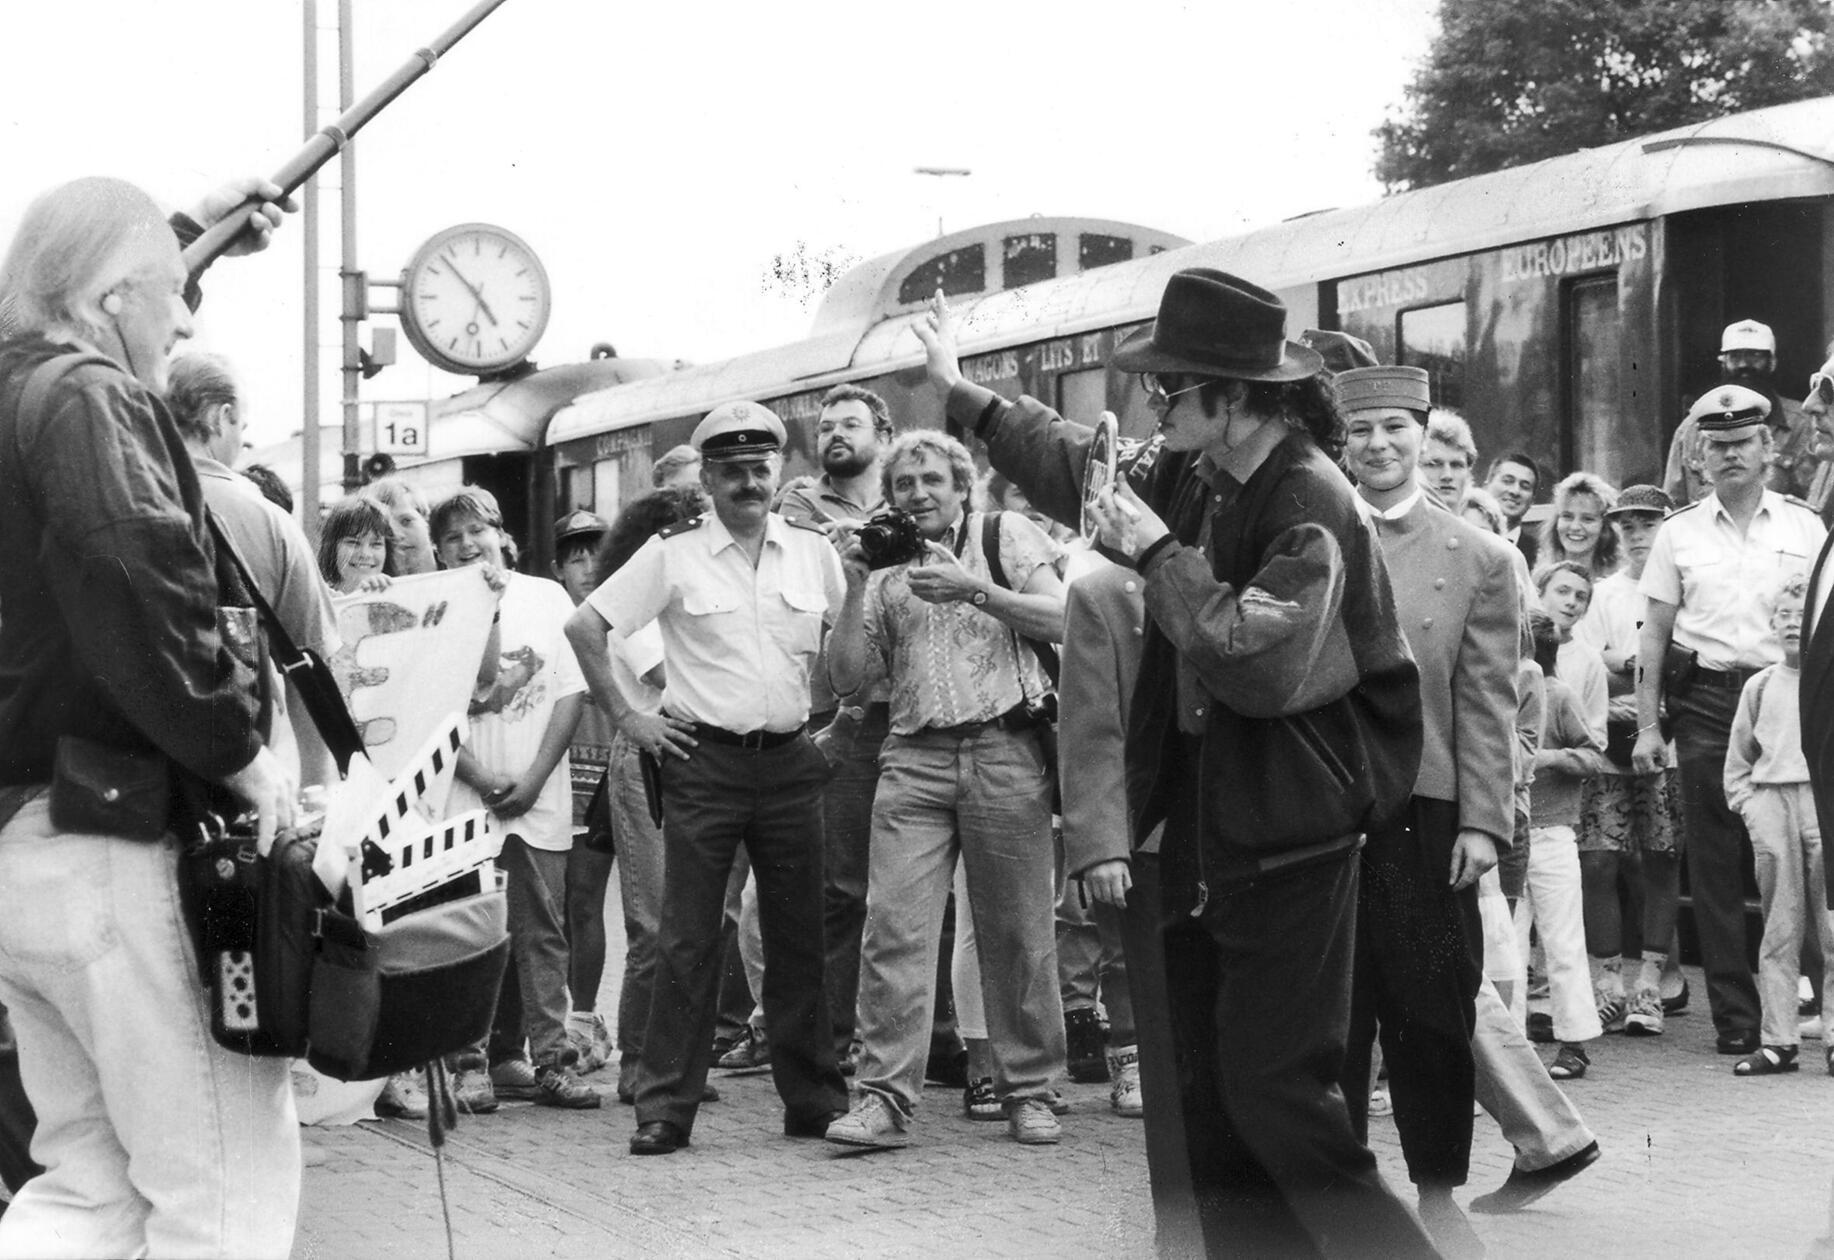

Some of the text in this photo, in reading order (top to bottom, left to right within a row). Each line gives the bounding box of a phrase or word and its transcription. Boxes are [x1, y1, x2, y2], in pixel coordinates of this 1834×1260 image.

[961, 350, 1019, 384] WAGONS
[1081, 332, 1103, 363] ET
[1336, 267, 1428, 314] EXPRESS
[1501, 222, 1647, 283] EUROPEENS
[385, 422, 417, 446] 1a
